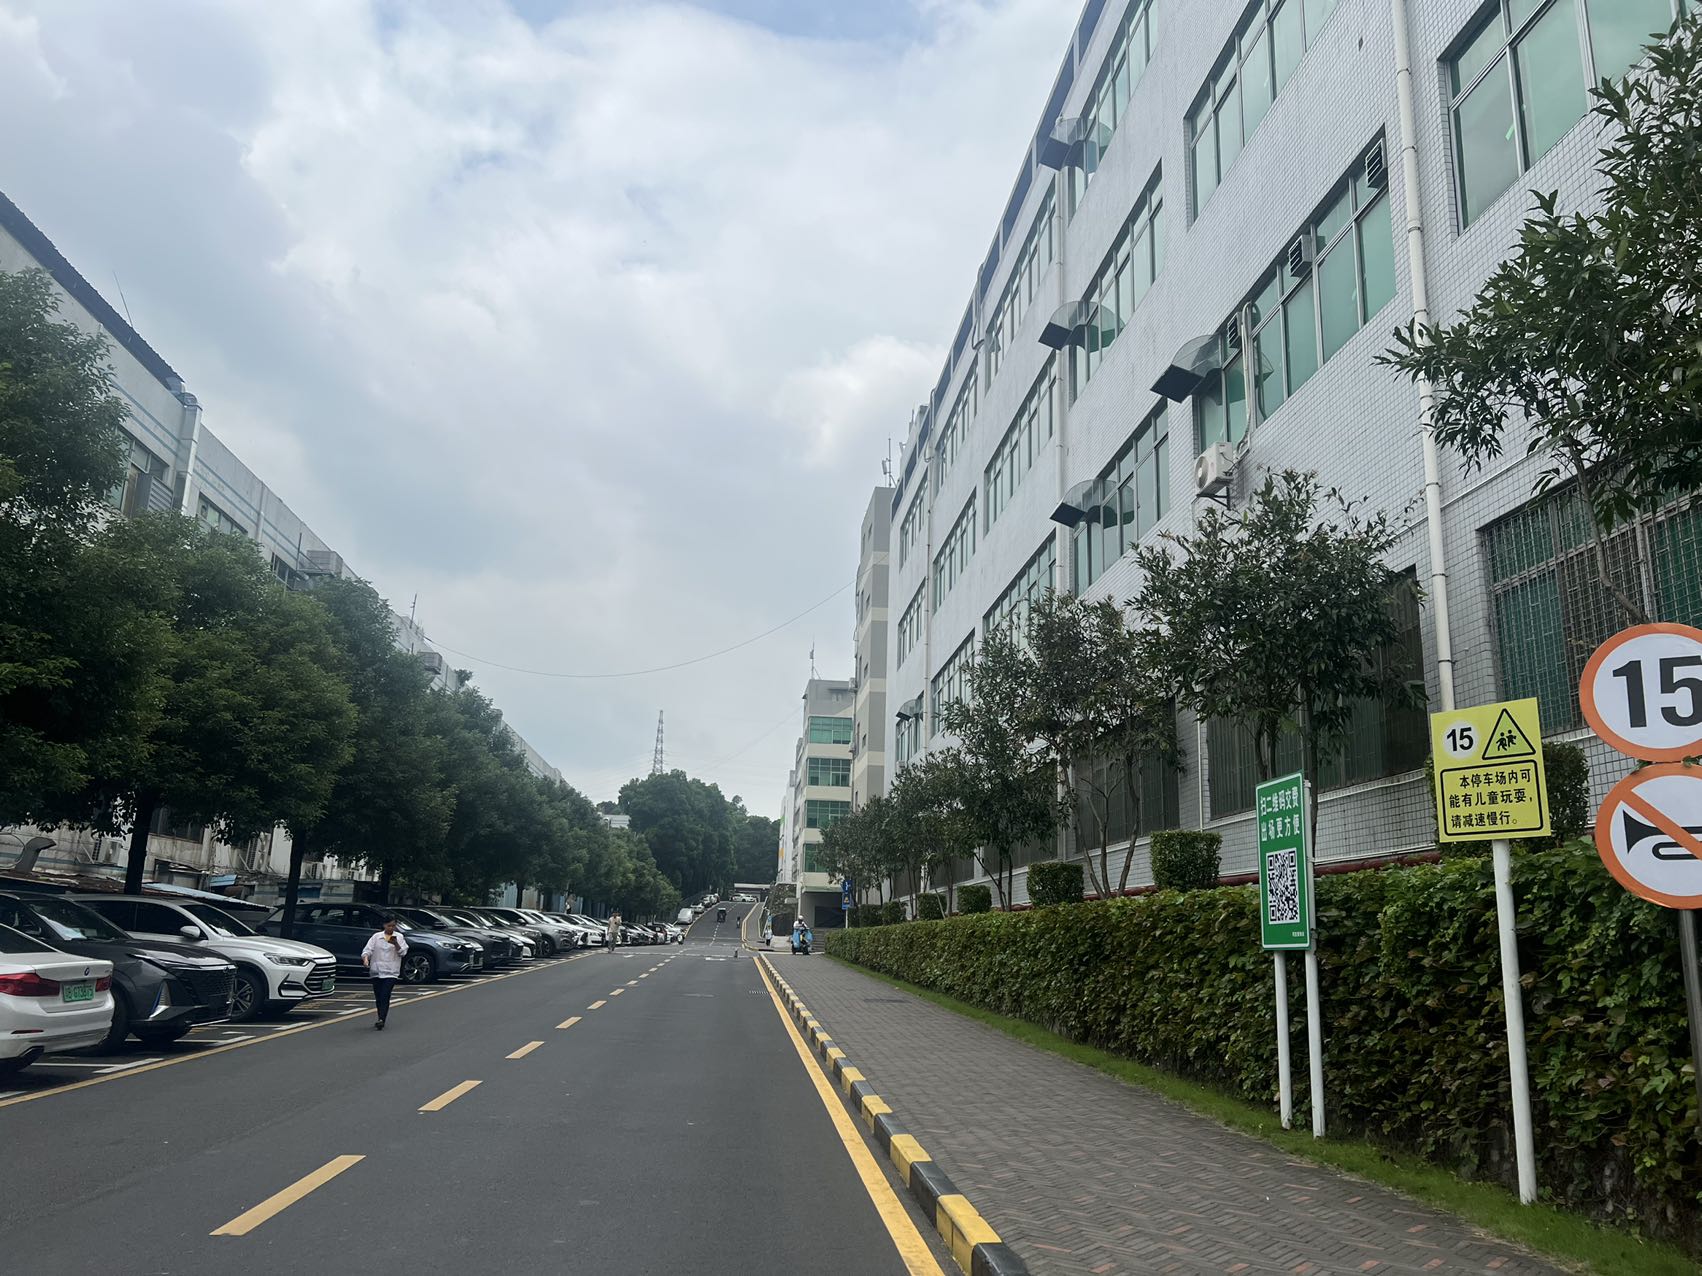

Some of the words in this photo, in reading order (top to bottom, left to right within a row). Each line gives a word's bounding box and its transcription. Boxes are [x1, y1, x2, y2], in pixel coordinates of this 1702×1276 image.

[1612, 655, 1702, 729] 15
[1446, 726, 1474, 752] 15
[1459, 768, 1532, 789] 本停车场内可
[1260, 786, 1299, 817] 扫二维码交费
[1261, 814, 1300, 842] 出场更方便
[1451, 810, 1518, 829] 请减速慢行。
